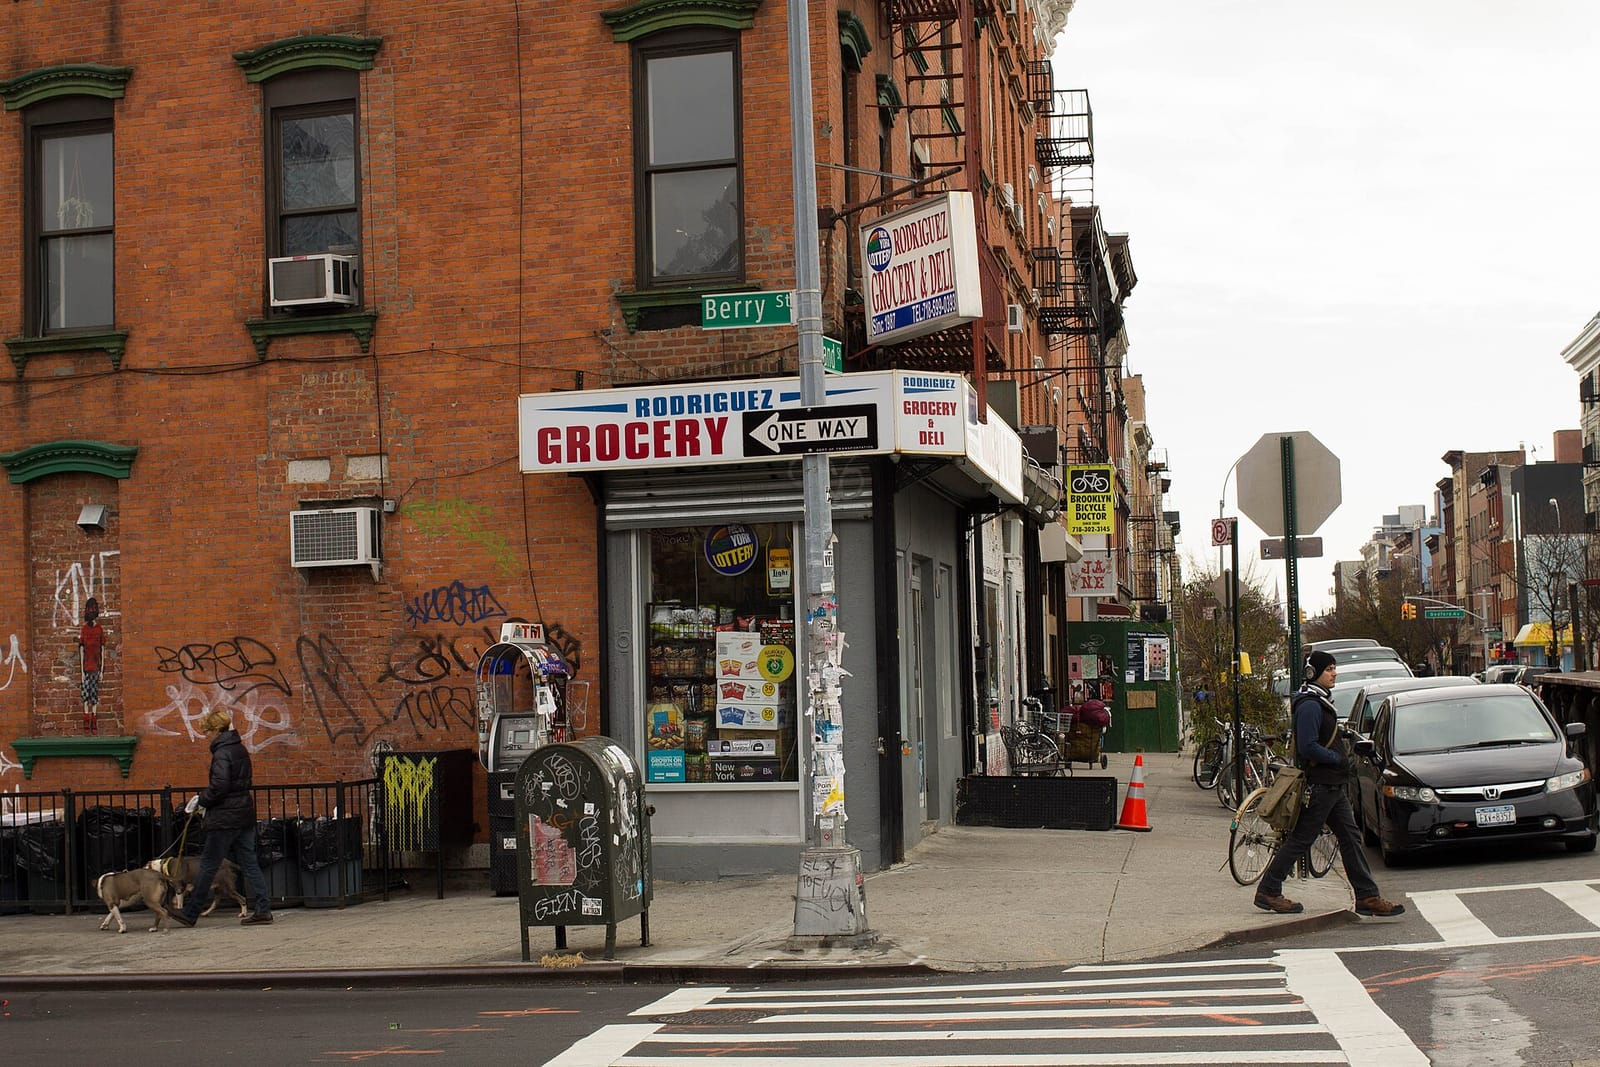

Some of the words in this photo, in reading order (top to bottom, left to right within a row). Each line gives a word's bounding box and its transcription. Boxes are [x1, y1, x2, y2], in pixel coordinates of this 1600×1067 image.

[892, 211, 948, 256] RODRIGUEZ
[871, 260, 917, 314] GROCERY
[920, 257, 928, 299] &
[928, 248, 954, 296] DELI
[705, 298, 766, 323] Berry
[776, 292, 791, 309] St
[903, 376, 956, 389] RODRIGUEZ
[635, 389, 774, 418] RODRIGUEZ
[903, 400, 957, 416] GROCERY
[767, 422, 807, 441] ONE
[818, 418, 859, 438] WAY
[927, 418, 935, 428] &
[537, 417, 729, 465] GROCERY
[919, 431, 945, 445] DELI
[1070, 494, 1112, 503] BROOKLYN
[1075, 503, 1107, 512] BICYCLE
[1075, 512, 1107, 521] DOCTOR
[730, 533, 752, 547] YORK
[712, 543, 755, 568] LOTTERY
[772, 569, 788, 578] Light
[715, 762, 735, 771] New
[715, 771, 736, 780] York
